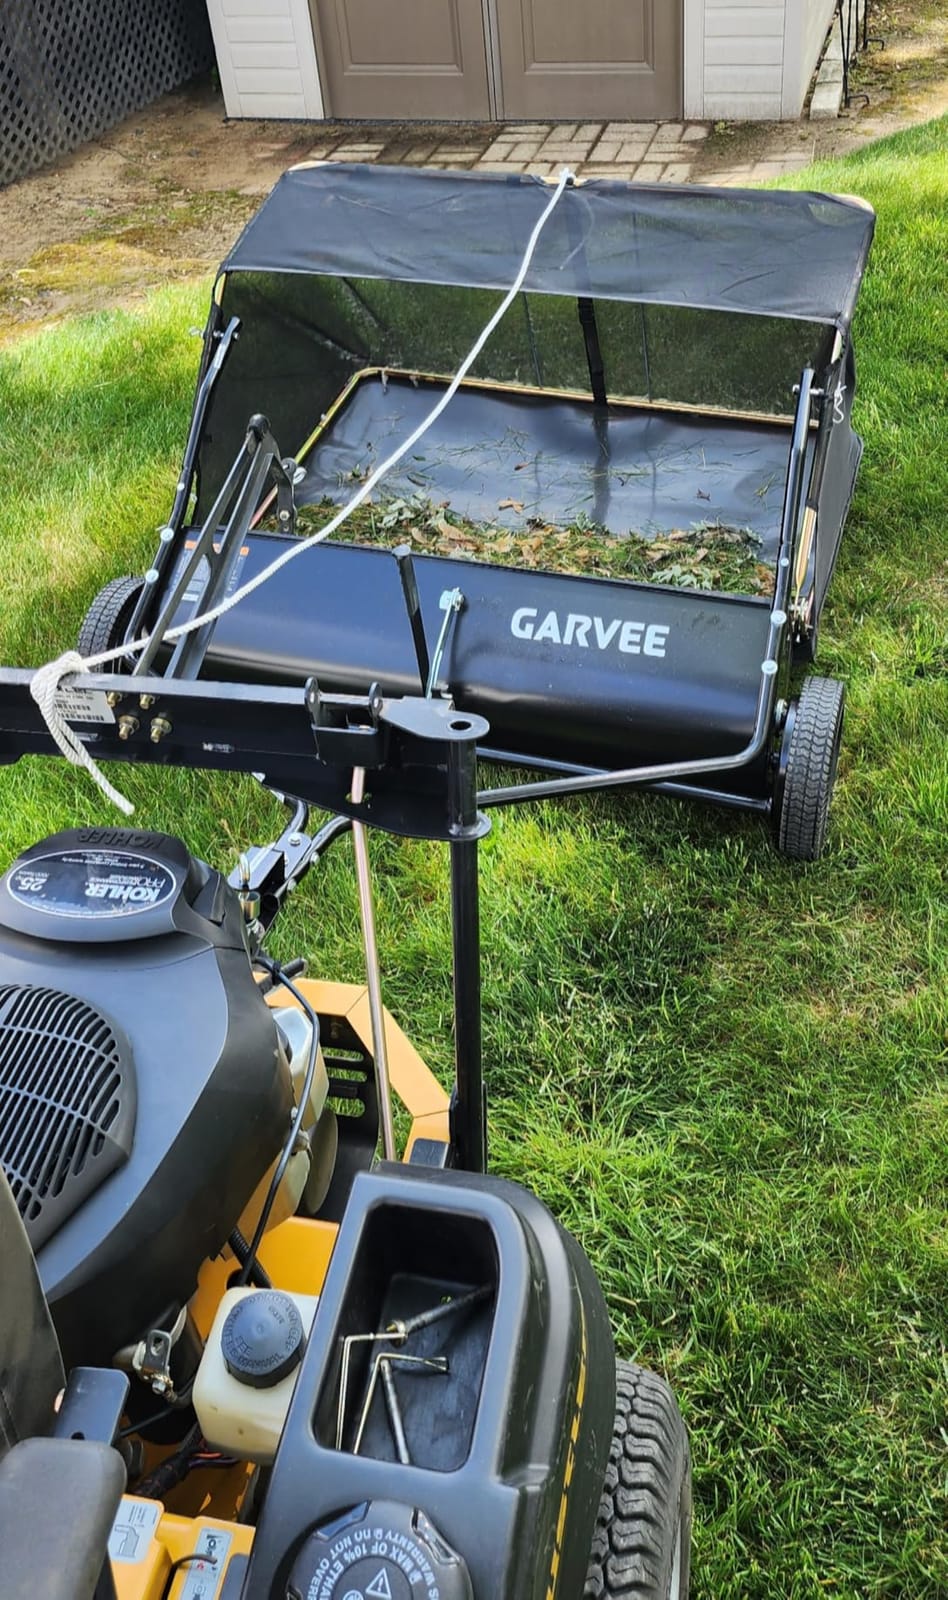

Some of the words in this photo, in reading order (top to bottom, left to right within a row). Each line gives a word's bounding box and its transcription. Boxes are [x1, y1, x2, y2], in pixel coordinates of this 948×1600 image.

[510, 607, 671, 658] GARVEE
[78, 829, 166, 849] KOHLER
[18, 876, 48, 891] 25
[85, 883, 161, 902] KOHLER
[330, 1536, 352, 1560] NOT
[343, 1543, 368, 1563] 10%
[371, 1541, 388, 1554] OF
[385, 1530, 436, 1586] WARRANTY
[389, 1545, 415, 1573] MAX
